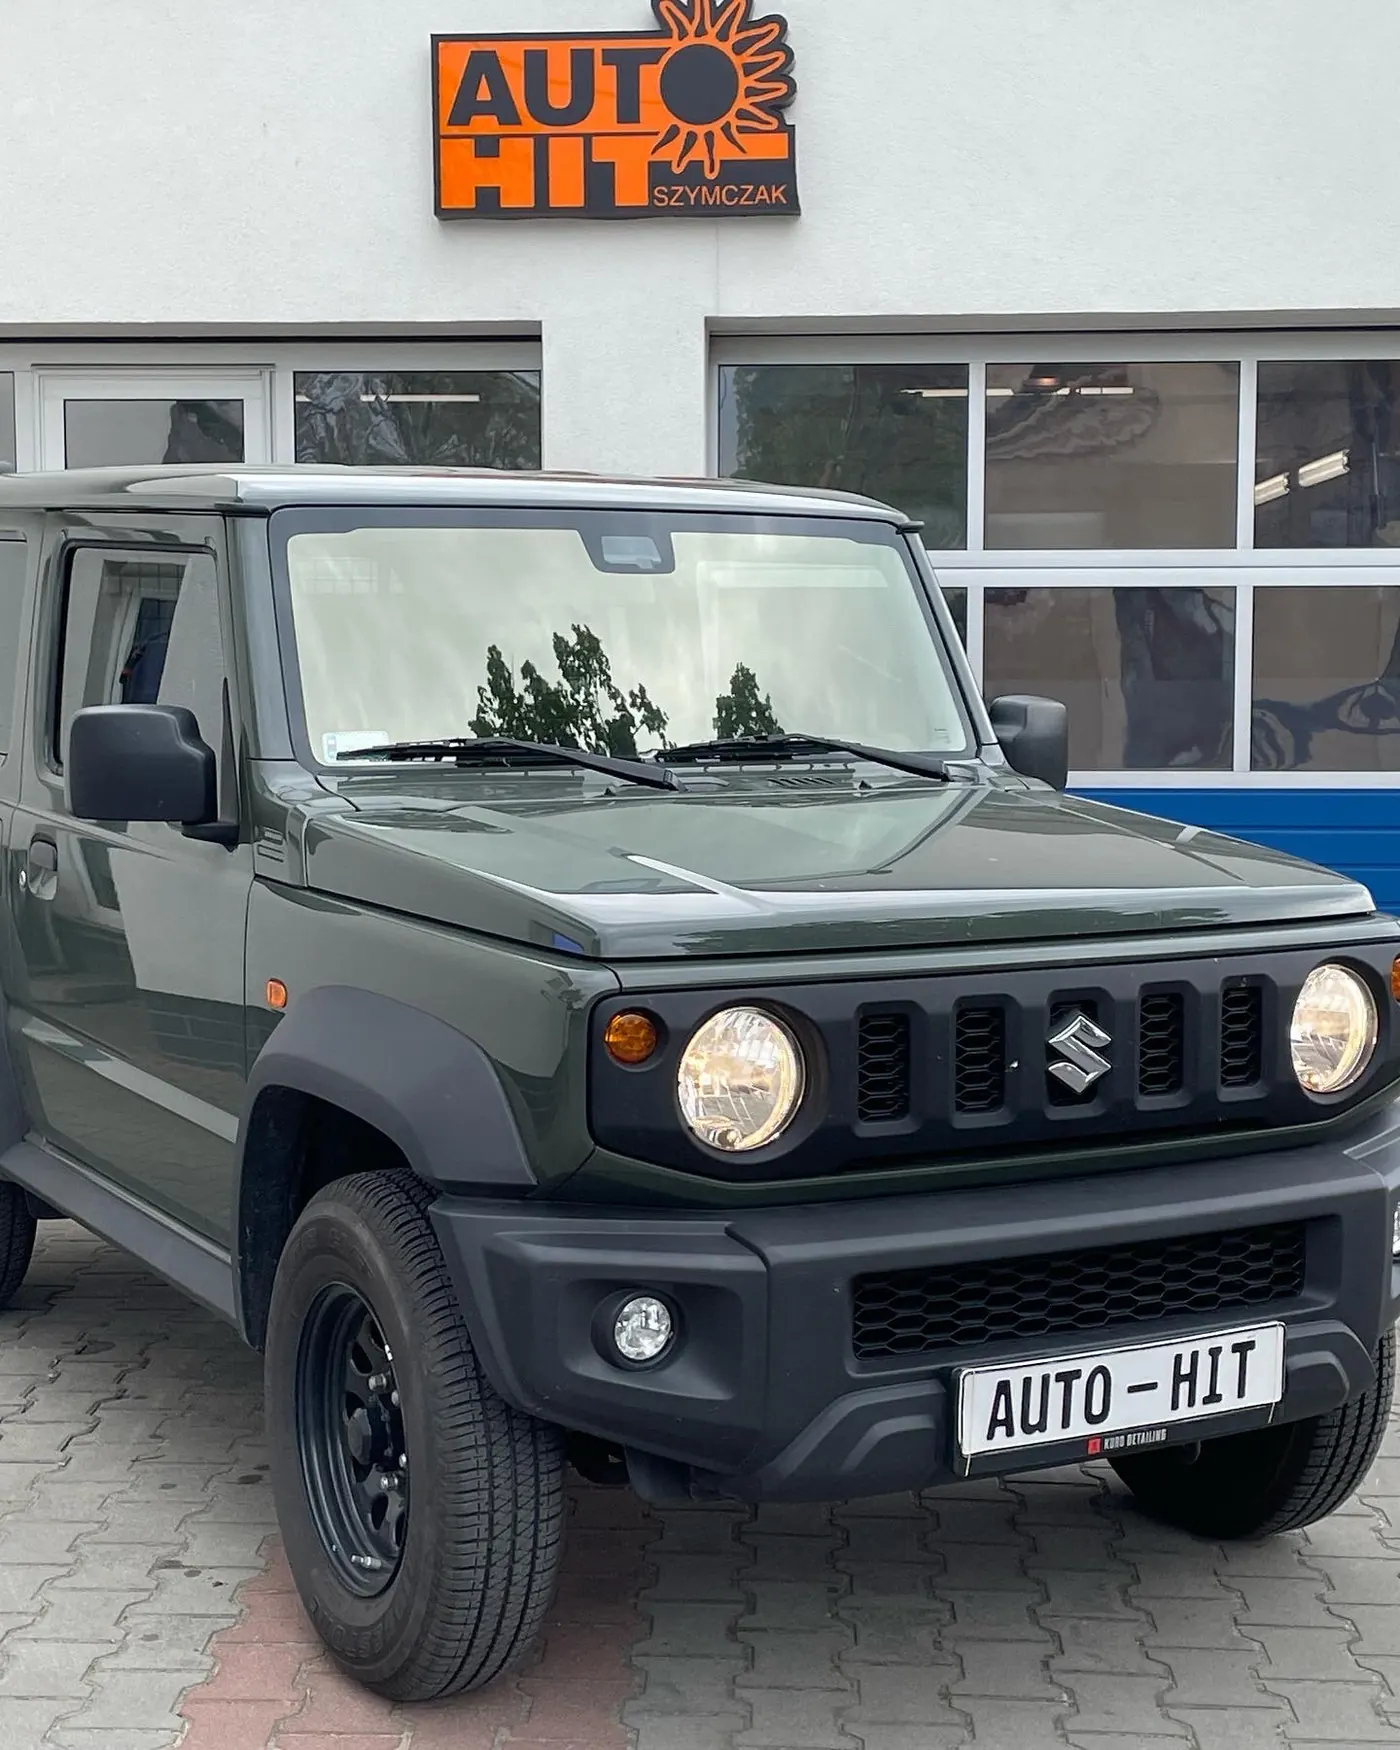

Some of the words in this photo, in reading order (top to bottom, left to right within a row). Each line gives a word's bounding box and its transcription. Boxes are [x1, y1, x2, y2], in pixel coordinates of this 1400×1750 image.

[447, 44, 740, 126] AUTO
[440, 136, 649, 208] HIT
[653, 184, 787, 206] SZYMCZAK
[986, 1365, 1112, 1440] AUTO
[1171, 1340, 1256, 1411] HIT
[1126, 1429, 1167, 1446] DETAILING
